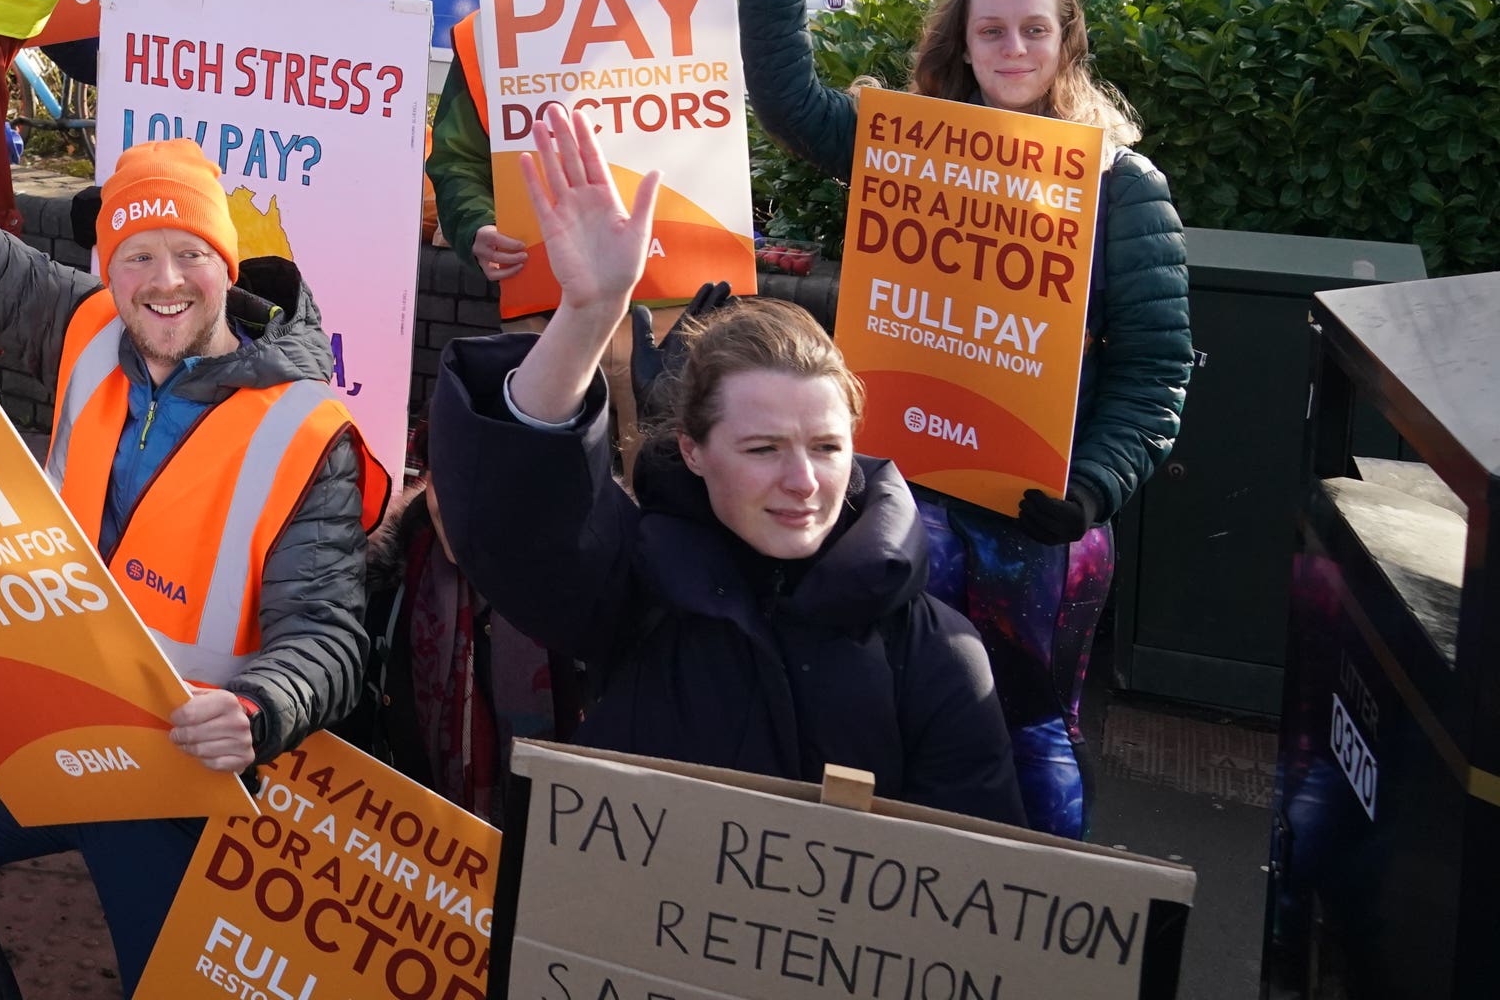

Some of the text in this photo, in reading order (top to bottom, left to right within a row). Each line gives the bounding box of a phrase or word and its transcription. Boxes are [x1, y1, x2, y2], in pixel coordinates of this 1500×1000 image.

[125, 32, 403, 118] HIGH STRESS?
[500, 61, 728, 96] RESTORATION FOR
[219, 123, 322, 186] PAY?
[865, 146, 1083, 213] NOT A FAIR WAGE
[869, 112, 1086, 180] £14/HOUR IS
[129, 198, 179, 220] BMA
[861, 175, 1079, 250] FOR A JUNIOR
[857, 208, 1075, 304] DOCTOR
[867, 315, 1043, 378] RESTORATION NOW
[869, 278, 1049, 355] FULL PAY
[927, 413, 978, 451] BMA
[21, 526, 76, 560] FOR
[145, 568, 187, 605] BMA
[78, 745, 140, 774] BMA
[1333, 705, 1373, 808] 0370
[266, 750, 489, 890] 14/HOUR
[312, 814, 337, 844] A
[344, 827, 420, 890] FAIR
[425, 874, 493, 938] WAG
[313, 856, 341, 893] A
[549, 783, 1139, 965] PAY RESTORATION
[655, 900, 1001, 1000] RETENTION
